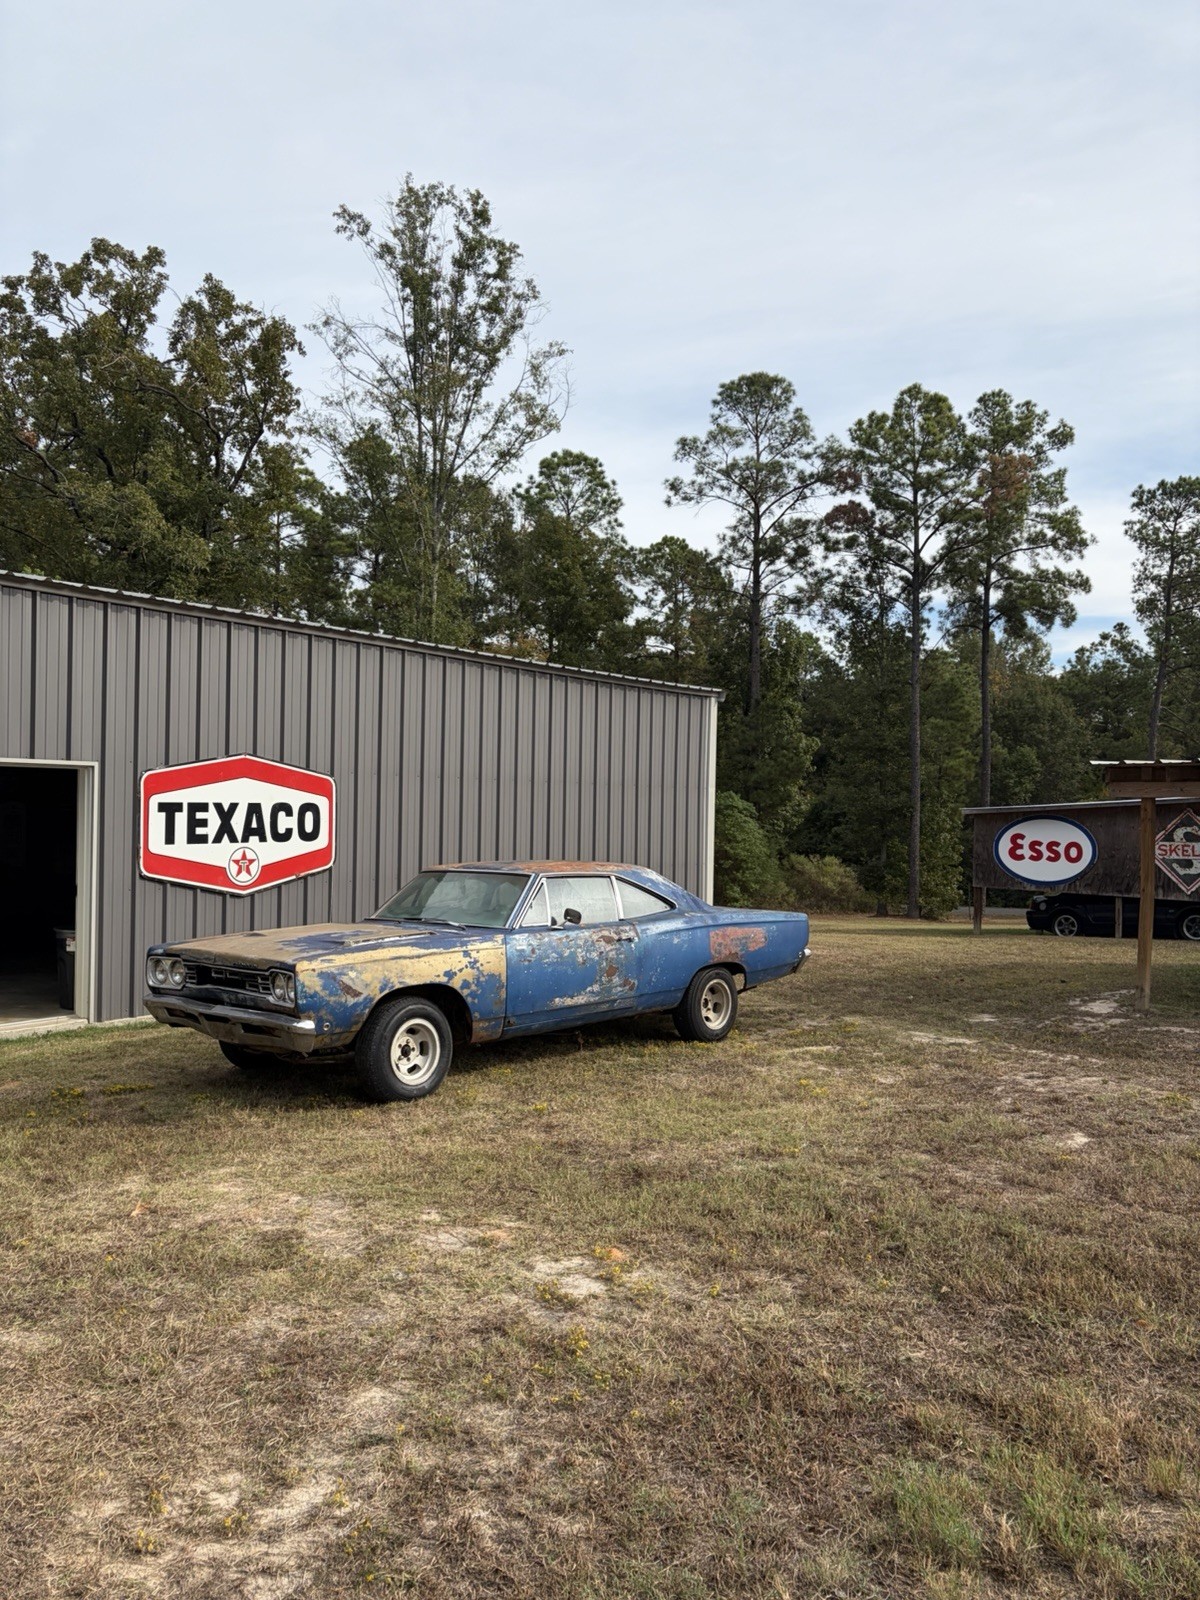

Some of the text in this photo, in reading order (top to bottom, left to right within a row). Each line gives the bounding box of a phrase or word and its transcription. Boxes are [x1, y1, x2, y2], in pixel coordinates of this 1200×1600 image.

[157, 802, 321, 845] TEXACO
[1157, 844, 1200, 857] SKEL
[239, 861, 249, 872] T
